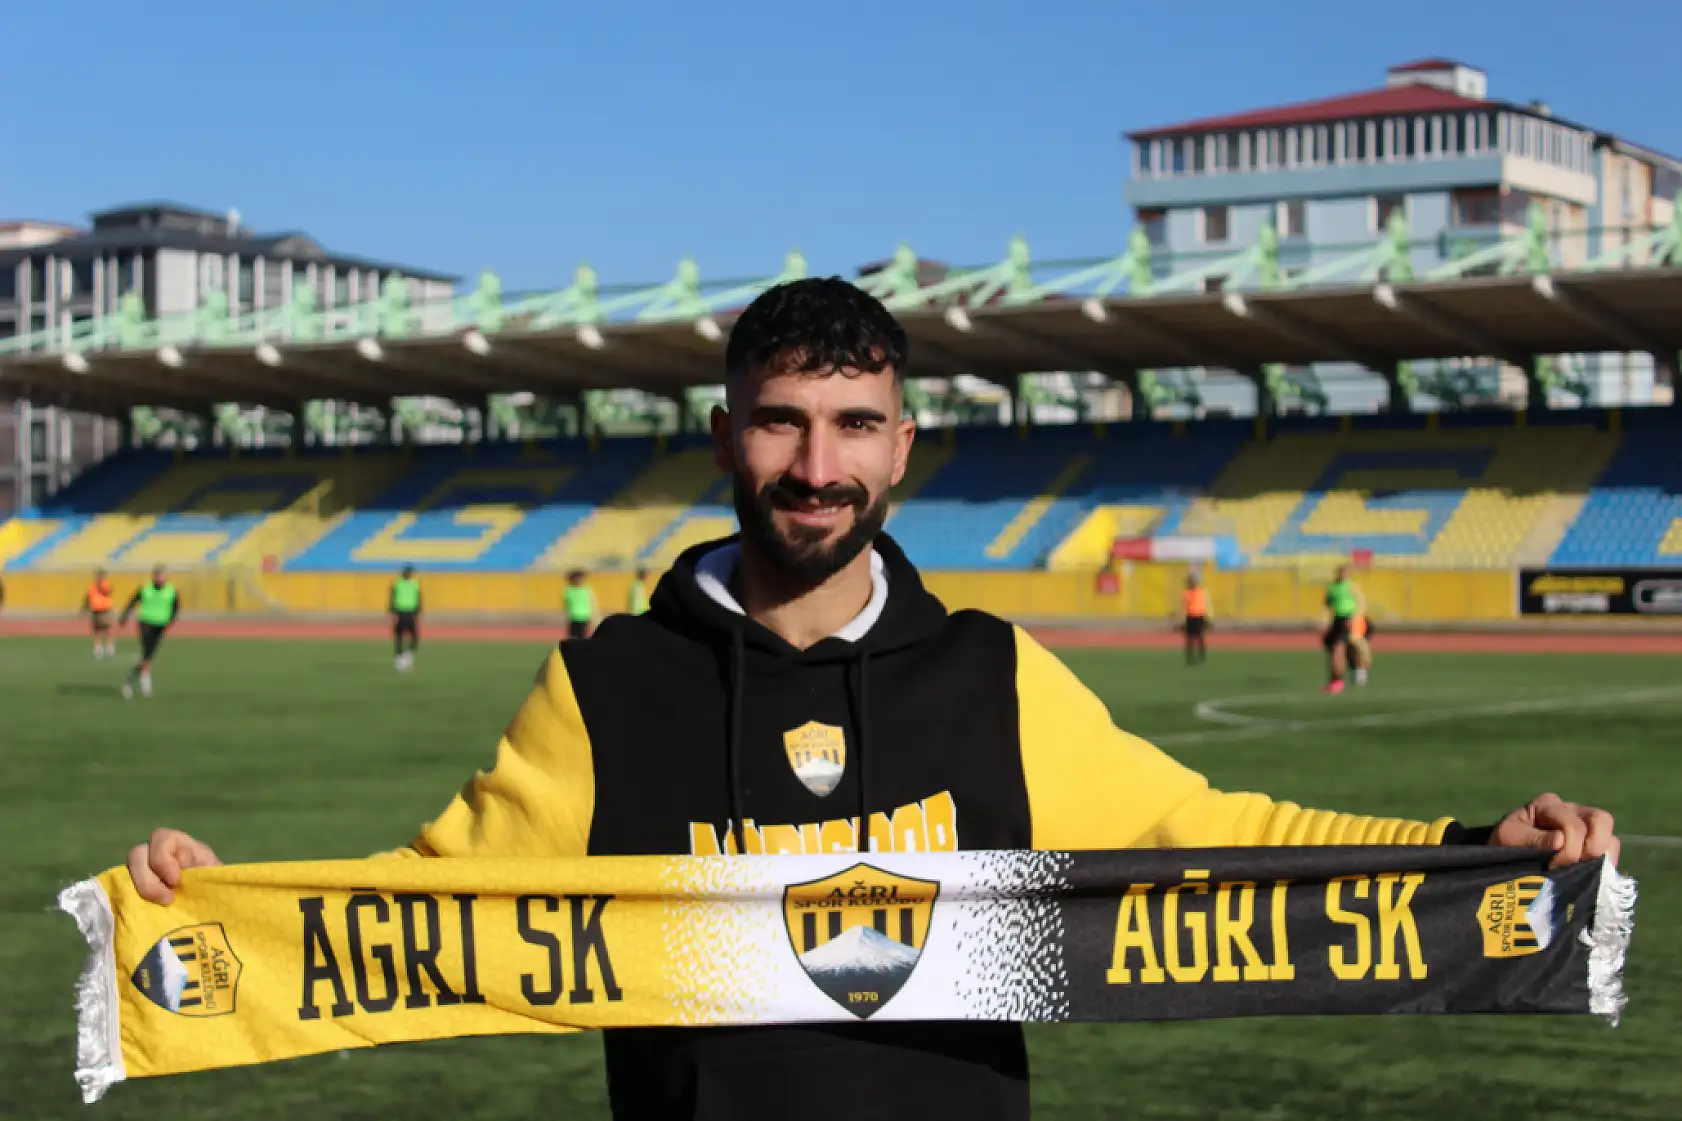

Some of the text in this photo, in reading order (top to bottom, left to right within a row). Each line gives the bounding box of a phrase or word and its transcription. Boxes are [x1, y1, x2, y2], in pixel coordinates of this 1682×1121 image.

[827, 880, 899, 899] AĞRI
[516, 894, 624, 1007] SK
[1325, 873, 1428, 981] SK
[848, 991, 879, 1003] 1970
